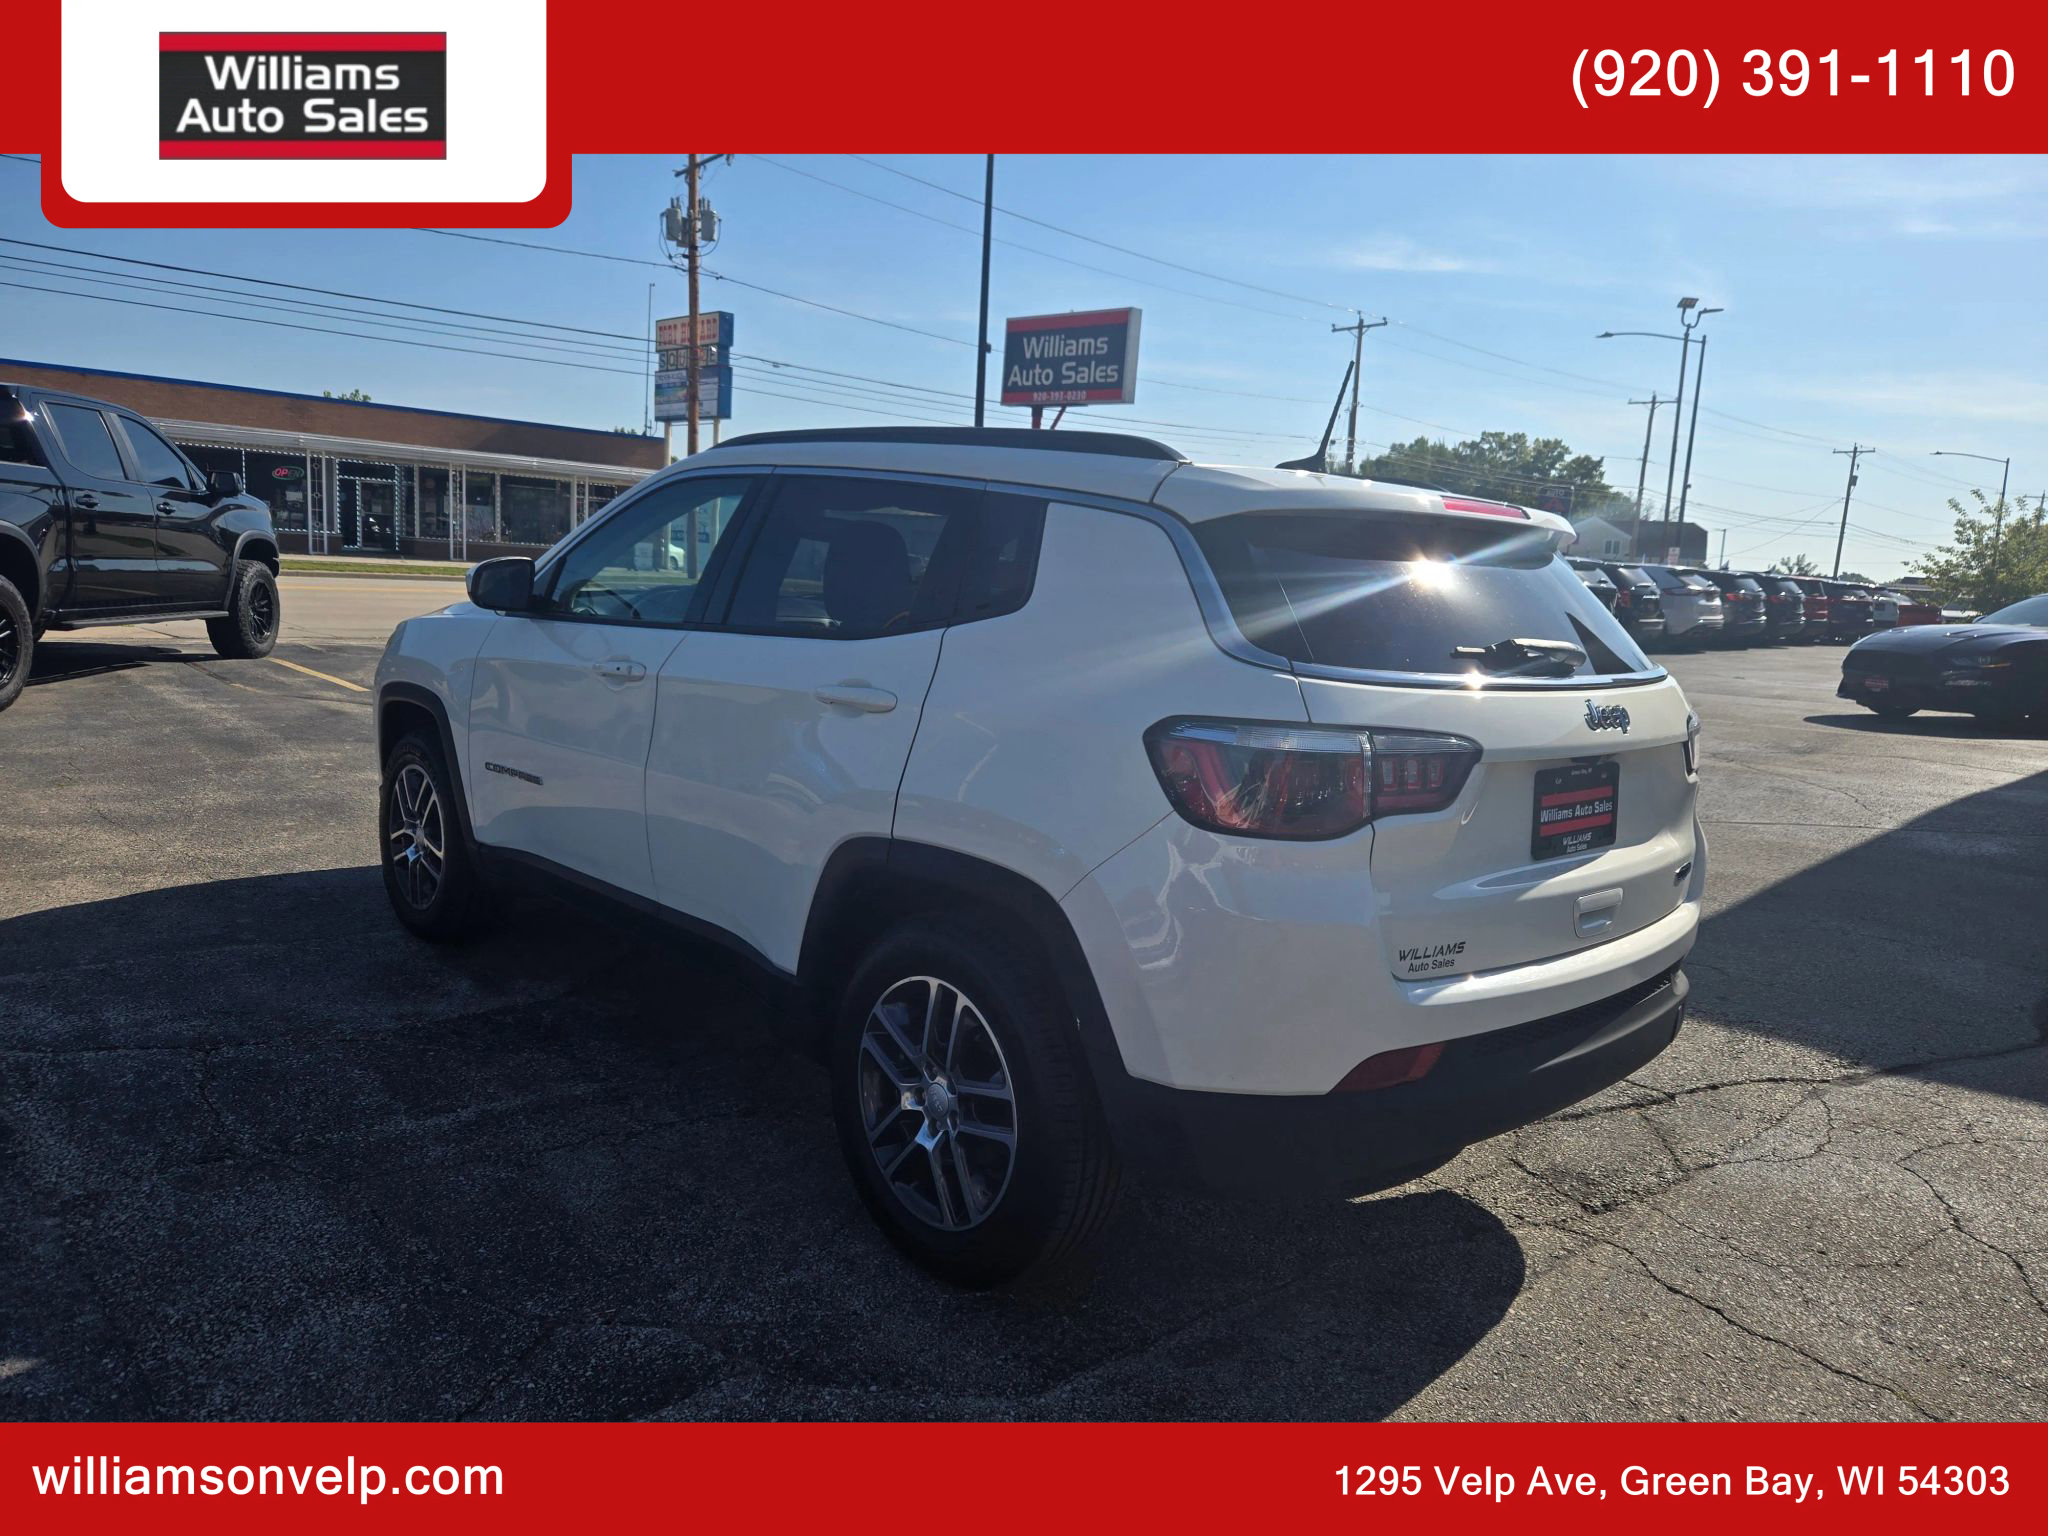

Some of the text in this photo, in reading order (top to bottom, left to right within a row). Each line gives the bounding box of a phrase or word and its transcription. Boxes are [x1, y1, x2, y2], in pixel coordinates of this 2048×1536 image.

[1023, 334, 1109, 359] Williams
[1007, 360, 1119, 387] Auto Sales
[1584, 699, 1631, 735] Jeep
[485, 761, 544, 786] COMP
[1540, 799, 1613, 823] Williams Auto Sales
[1562, 832, 1592, 846] WILLIAMS
[1399, 941, 1466, 962] WILLIAMS
[1407, 958, 1455, 973] Auto Sales
